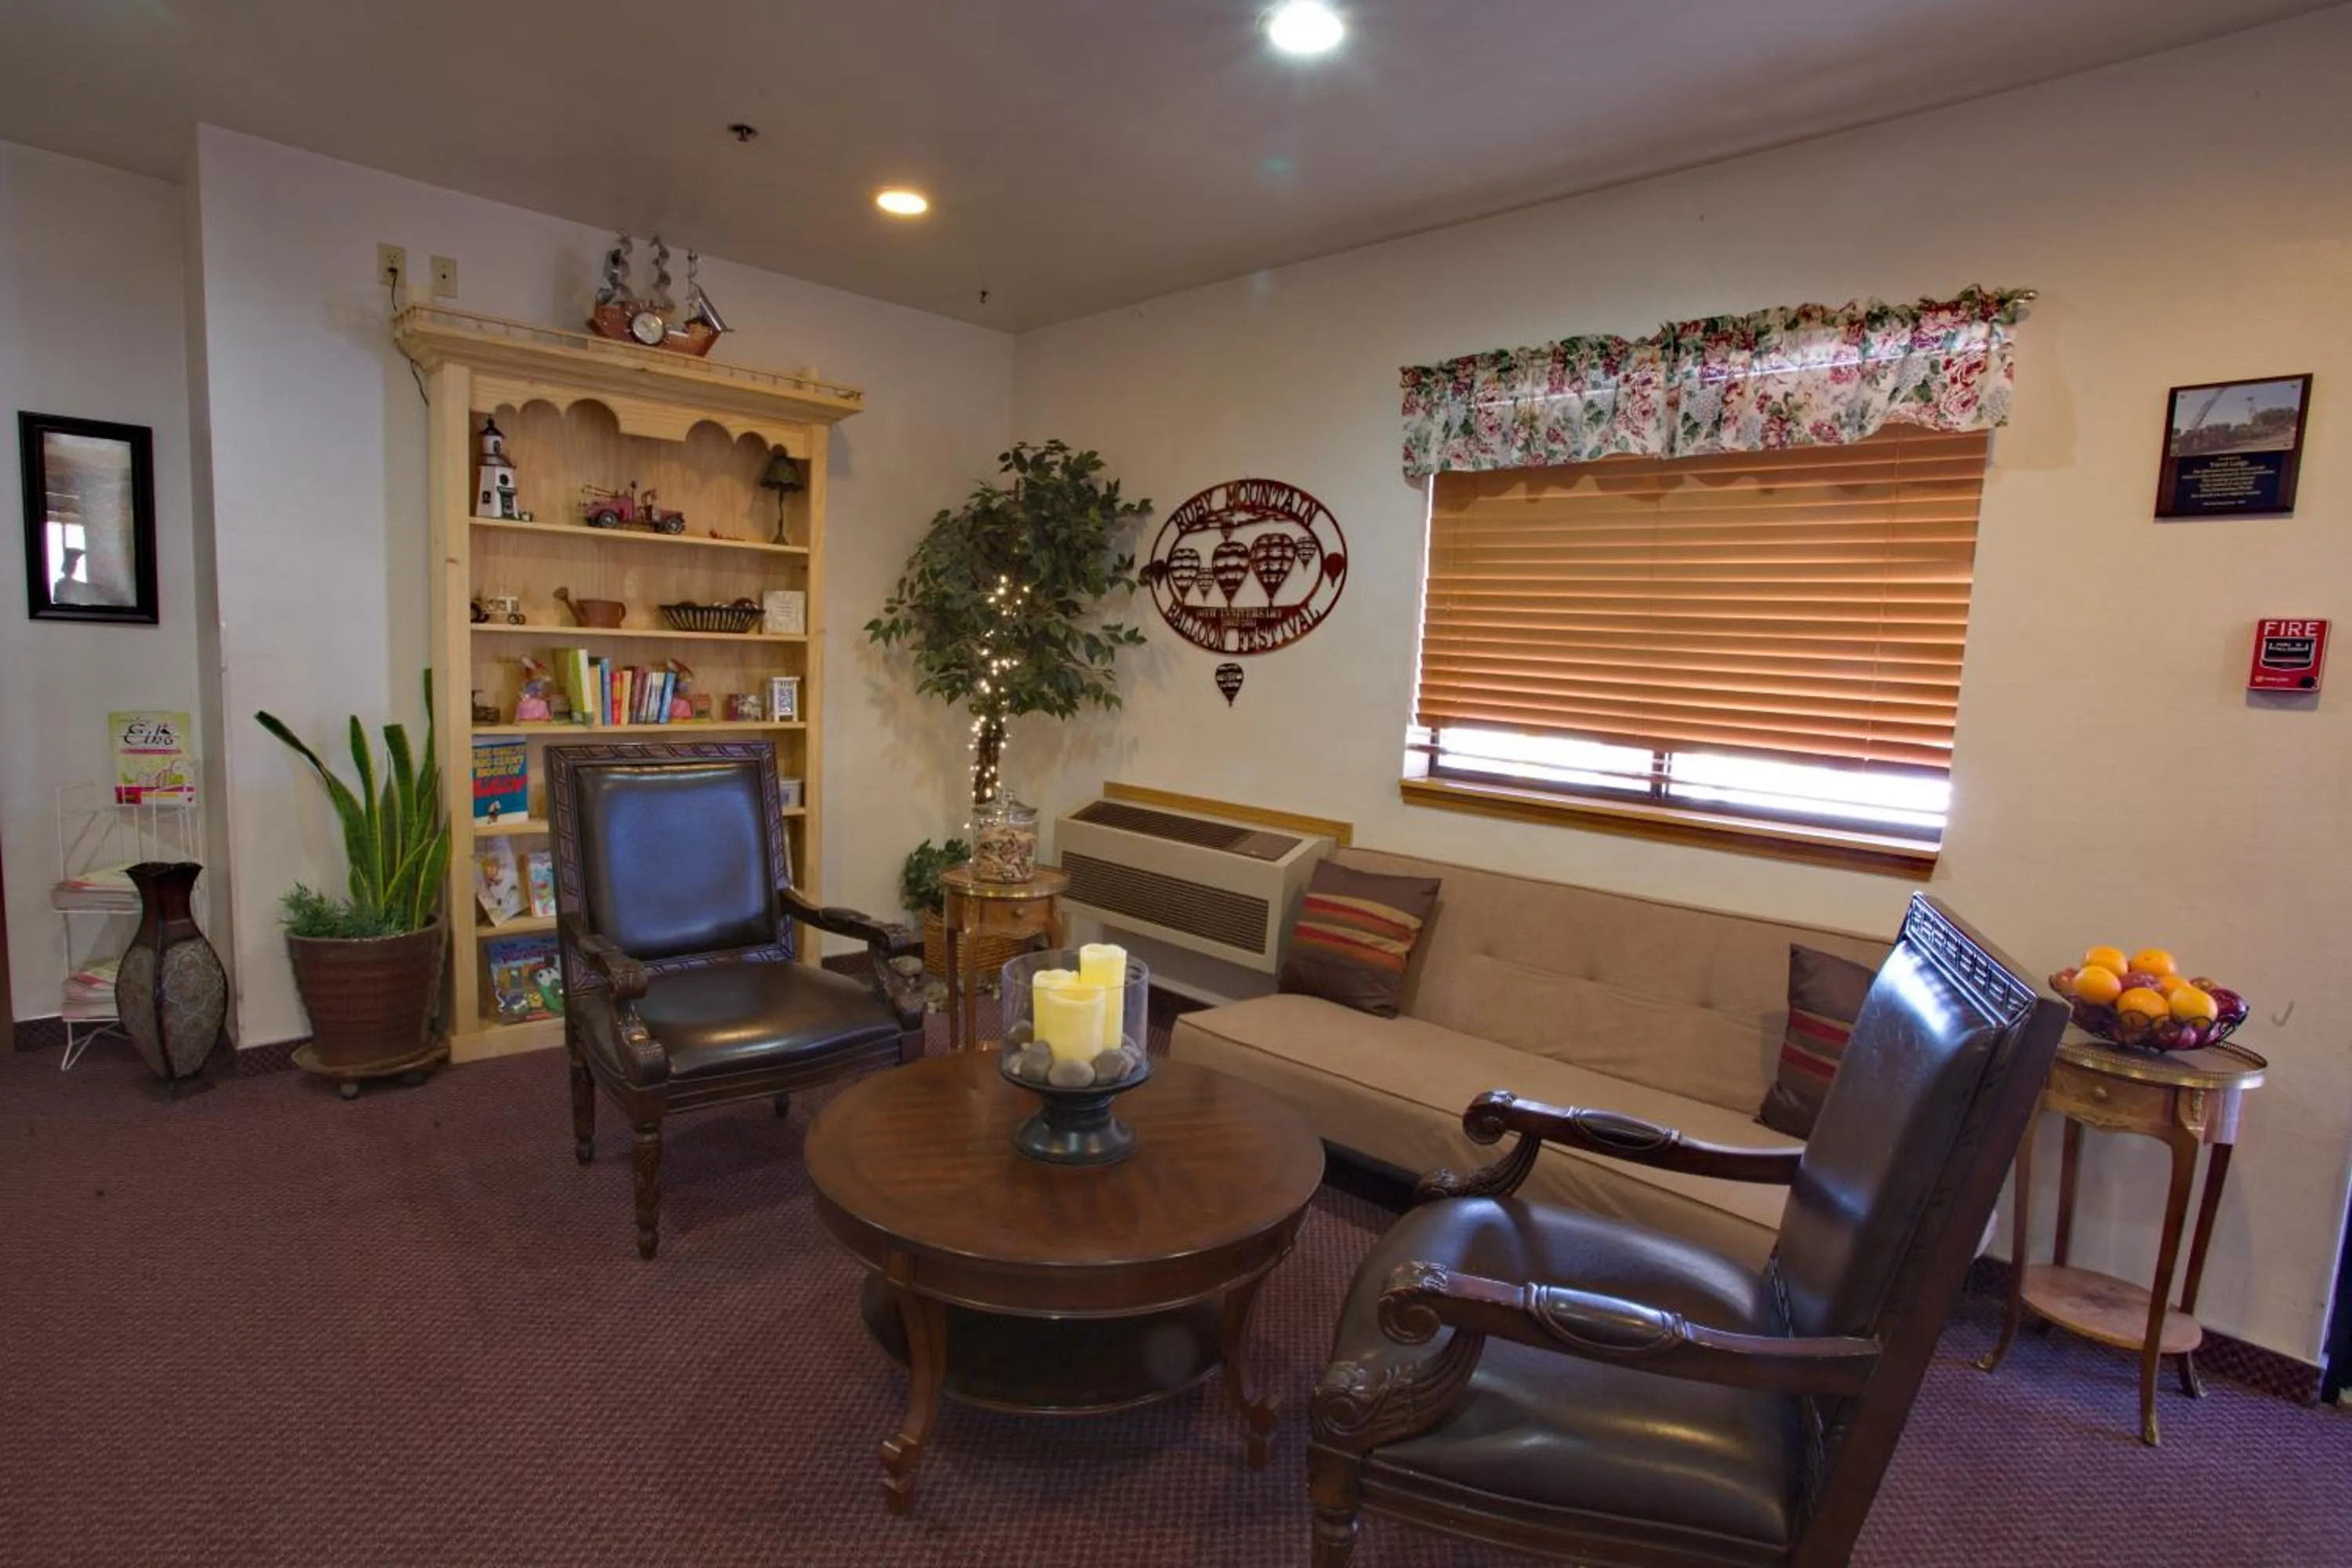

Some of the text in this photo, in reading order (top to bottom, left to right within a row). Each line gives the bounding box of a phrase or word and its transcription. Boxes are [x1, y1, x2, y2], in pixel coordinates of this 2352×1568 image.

[1176, 482, 1318, 529] RUBY MOUNTAIN
[1167, 604, 1320, 650] BALLOON FESTIVAL
[2263, 622, 2320, 636] FIRE
